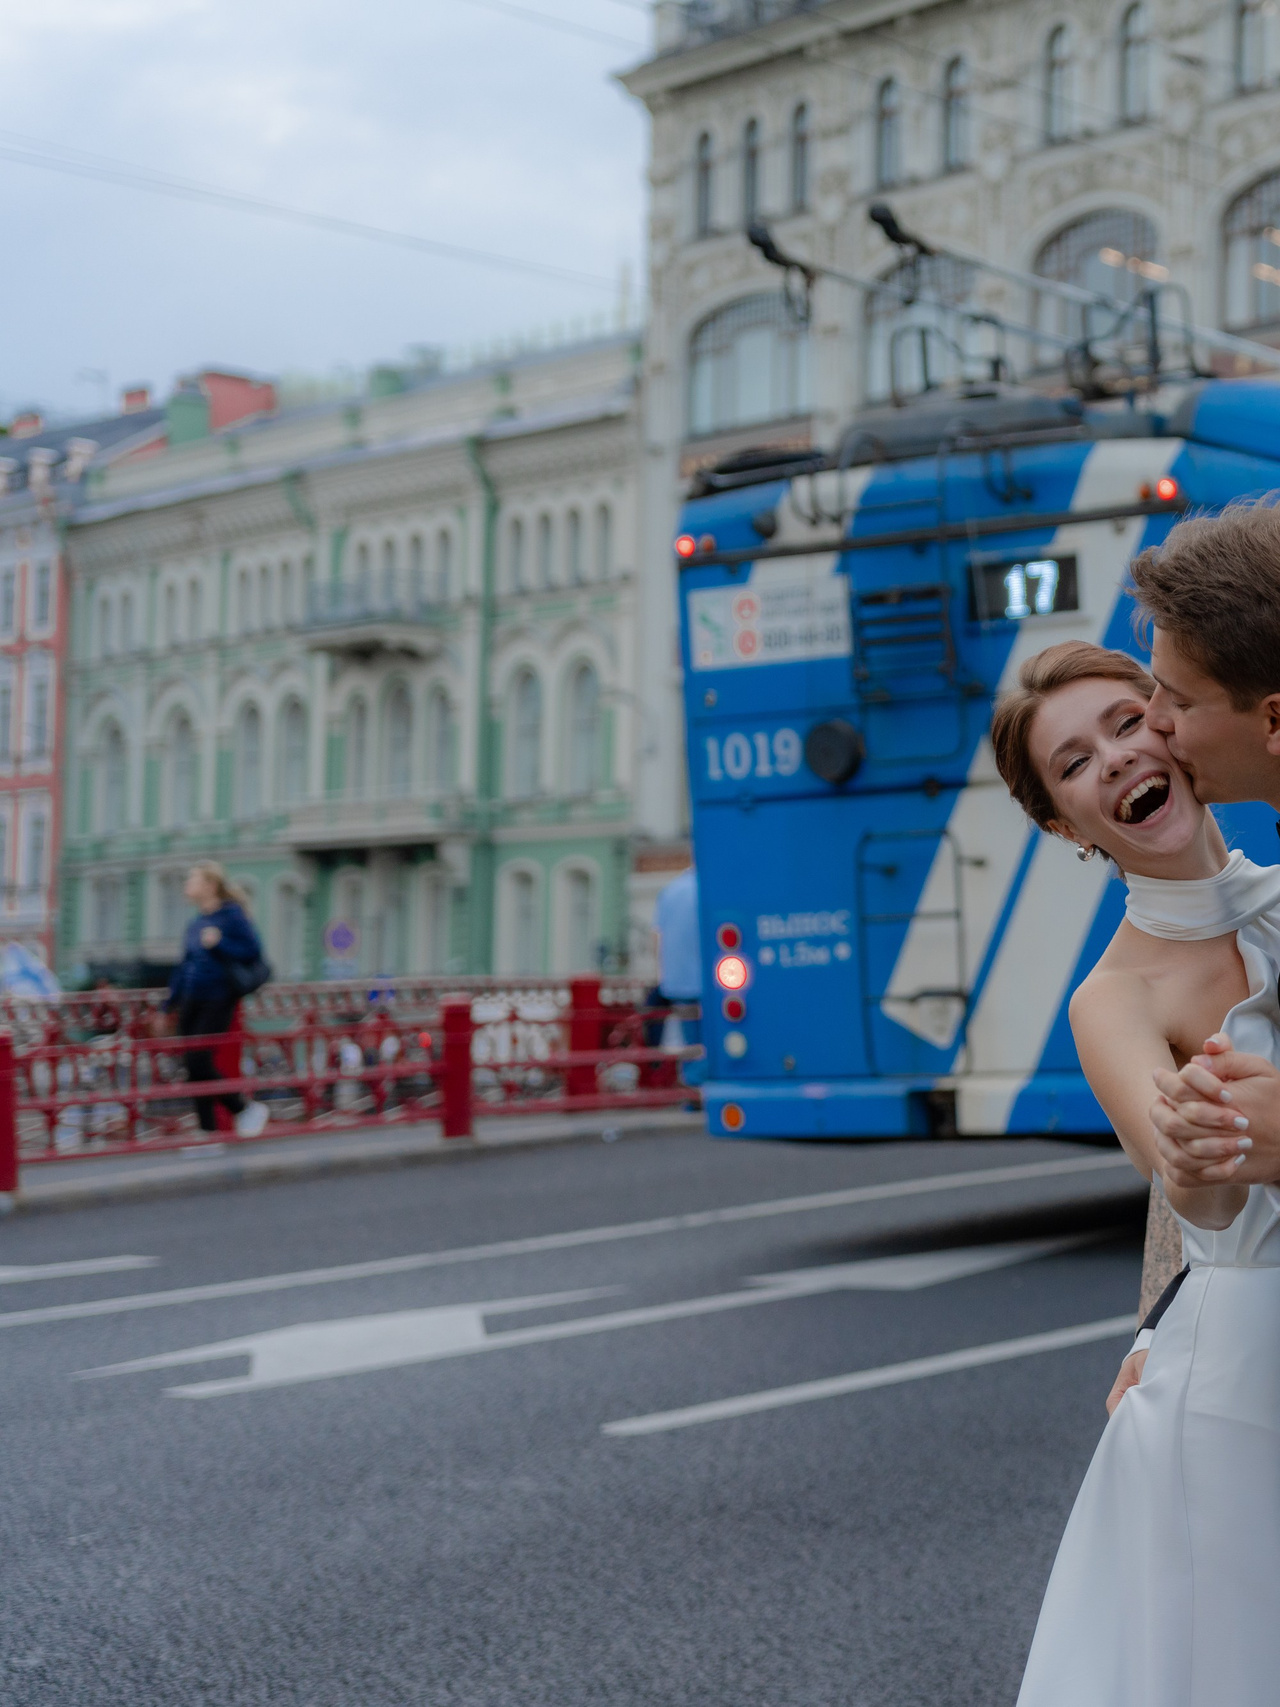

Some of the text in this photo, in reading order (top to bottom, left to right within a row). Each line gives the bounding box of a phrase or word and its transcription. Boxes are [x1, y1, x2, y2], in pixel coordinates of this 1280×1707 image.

[1004, 560, 1059, 619] 17
[705, 727, 802, 781] 1019
[757, 909, 850, 940] ВЫНОС
